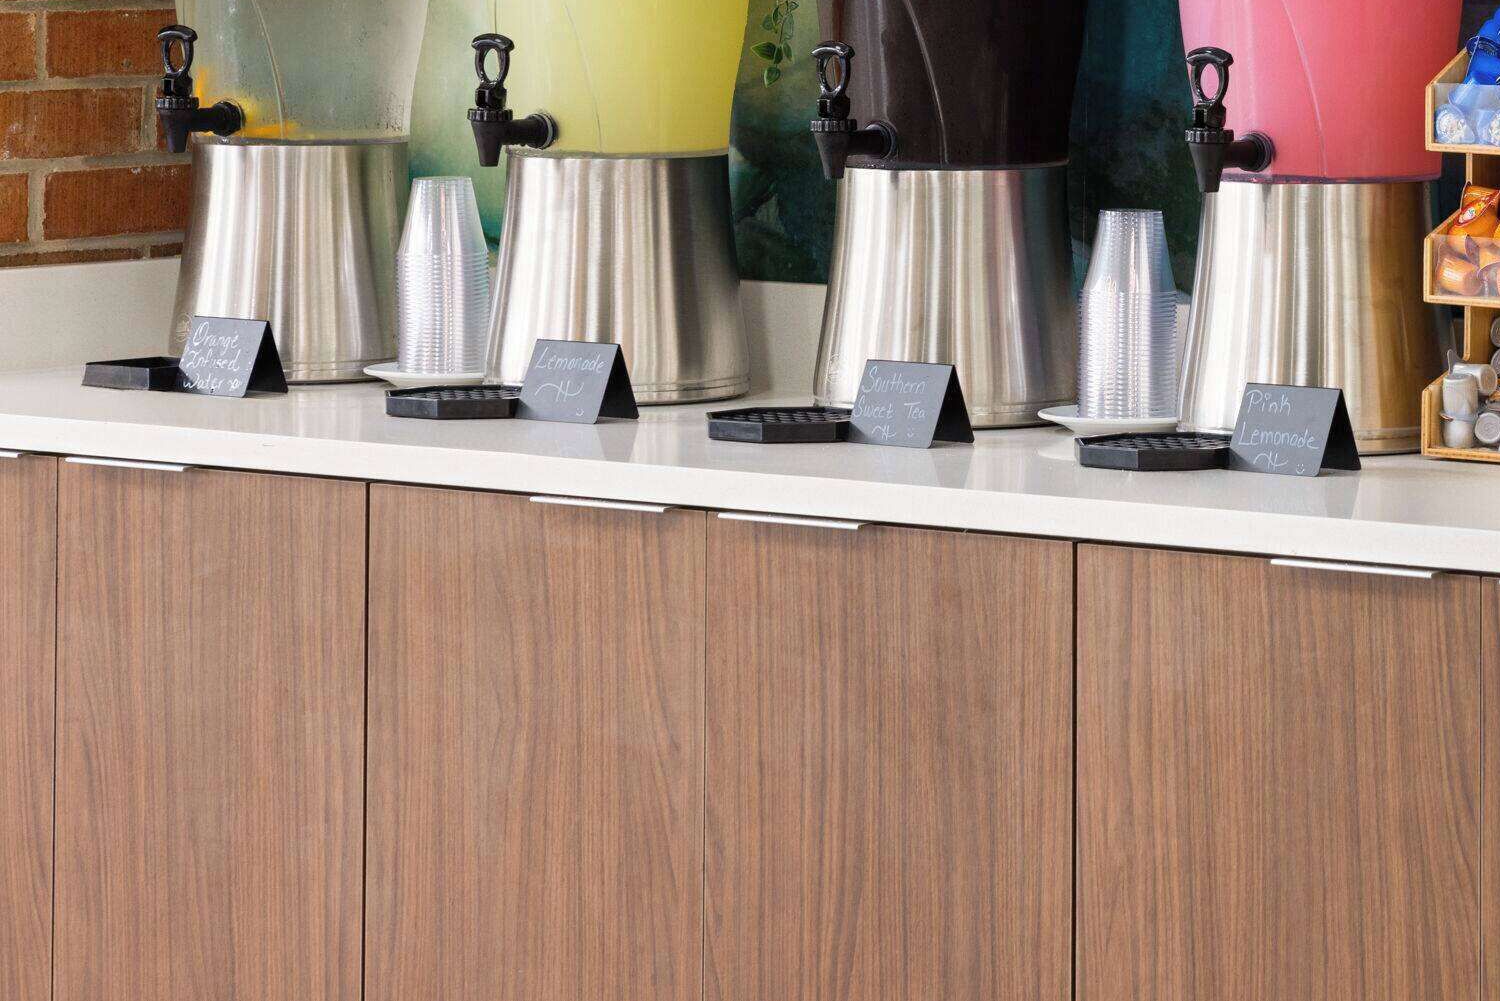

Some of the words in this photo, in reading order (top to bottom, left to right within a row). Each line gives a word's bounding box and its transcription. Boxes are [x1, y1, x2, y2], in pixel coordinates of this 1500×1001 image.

[192, 321, 239, 355] Orange
[186, 349, 241, 372] Infused
[534, 346, 607, 374] Lemonade
[183, 373, 223, 391] Water
[862, 365, 927, 395] Southern
[853, 394, 895, 419] Sweet
[903, 401, 927, 419] Tea
[1246, 389, 1291, 415] Pink
[1238, 421, 1320, 450] Lemonade
